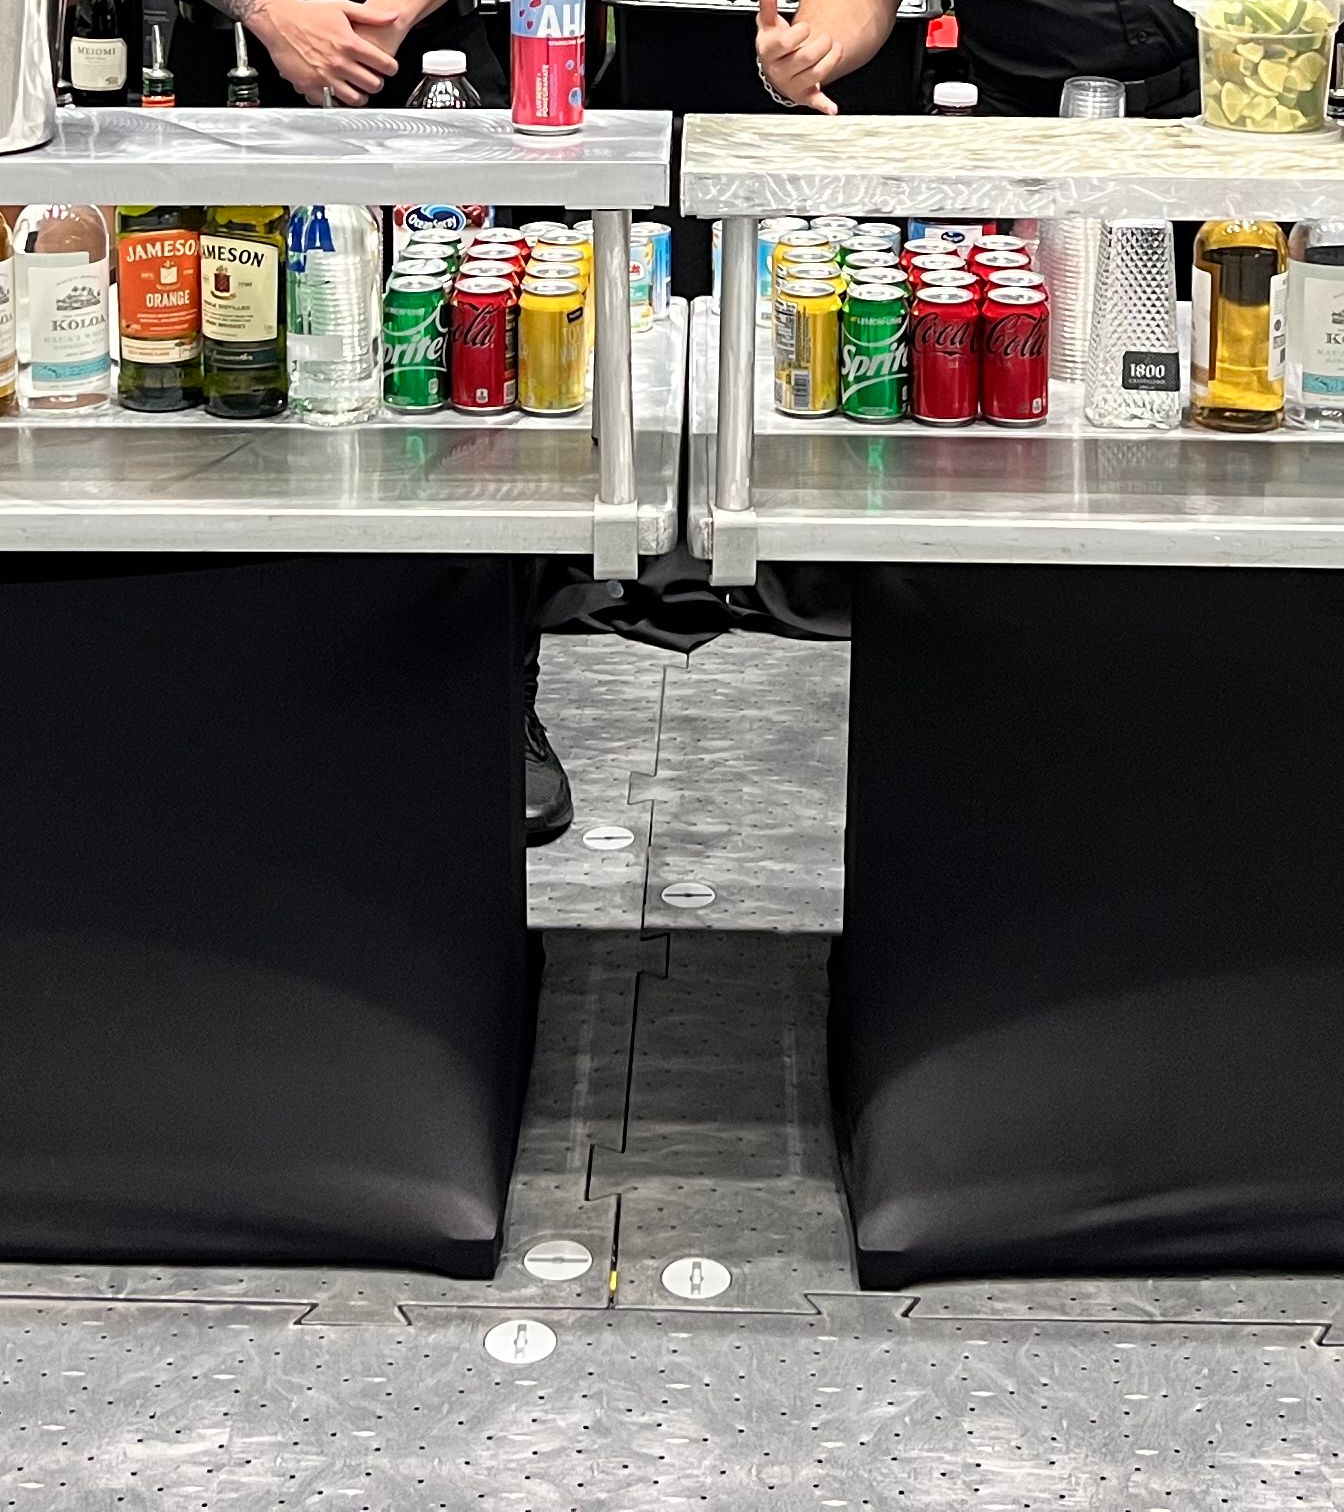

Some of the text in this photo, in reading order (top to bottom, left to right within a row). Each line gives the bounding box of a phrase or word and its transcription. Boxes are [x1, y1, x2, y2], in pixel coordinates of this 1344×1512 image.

[536, 3, 586, 38] AH
[76, 46, 116, 56] MEIOMI
[126, 239, 200, 262] JAMESO
[145, 289, 191, 308] ORANGE
[50, 313, 106, 332] KOLOA
[911, 311, 971, 352] Coca
[985, 313, 1047, 359] Cola
[1129, 363, 1166, 378] 1800
